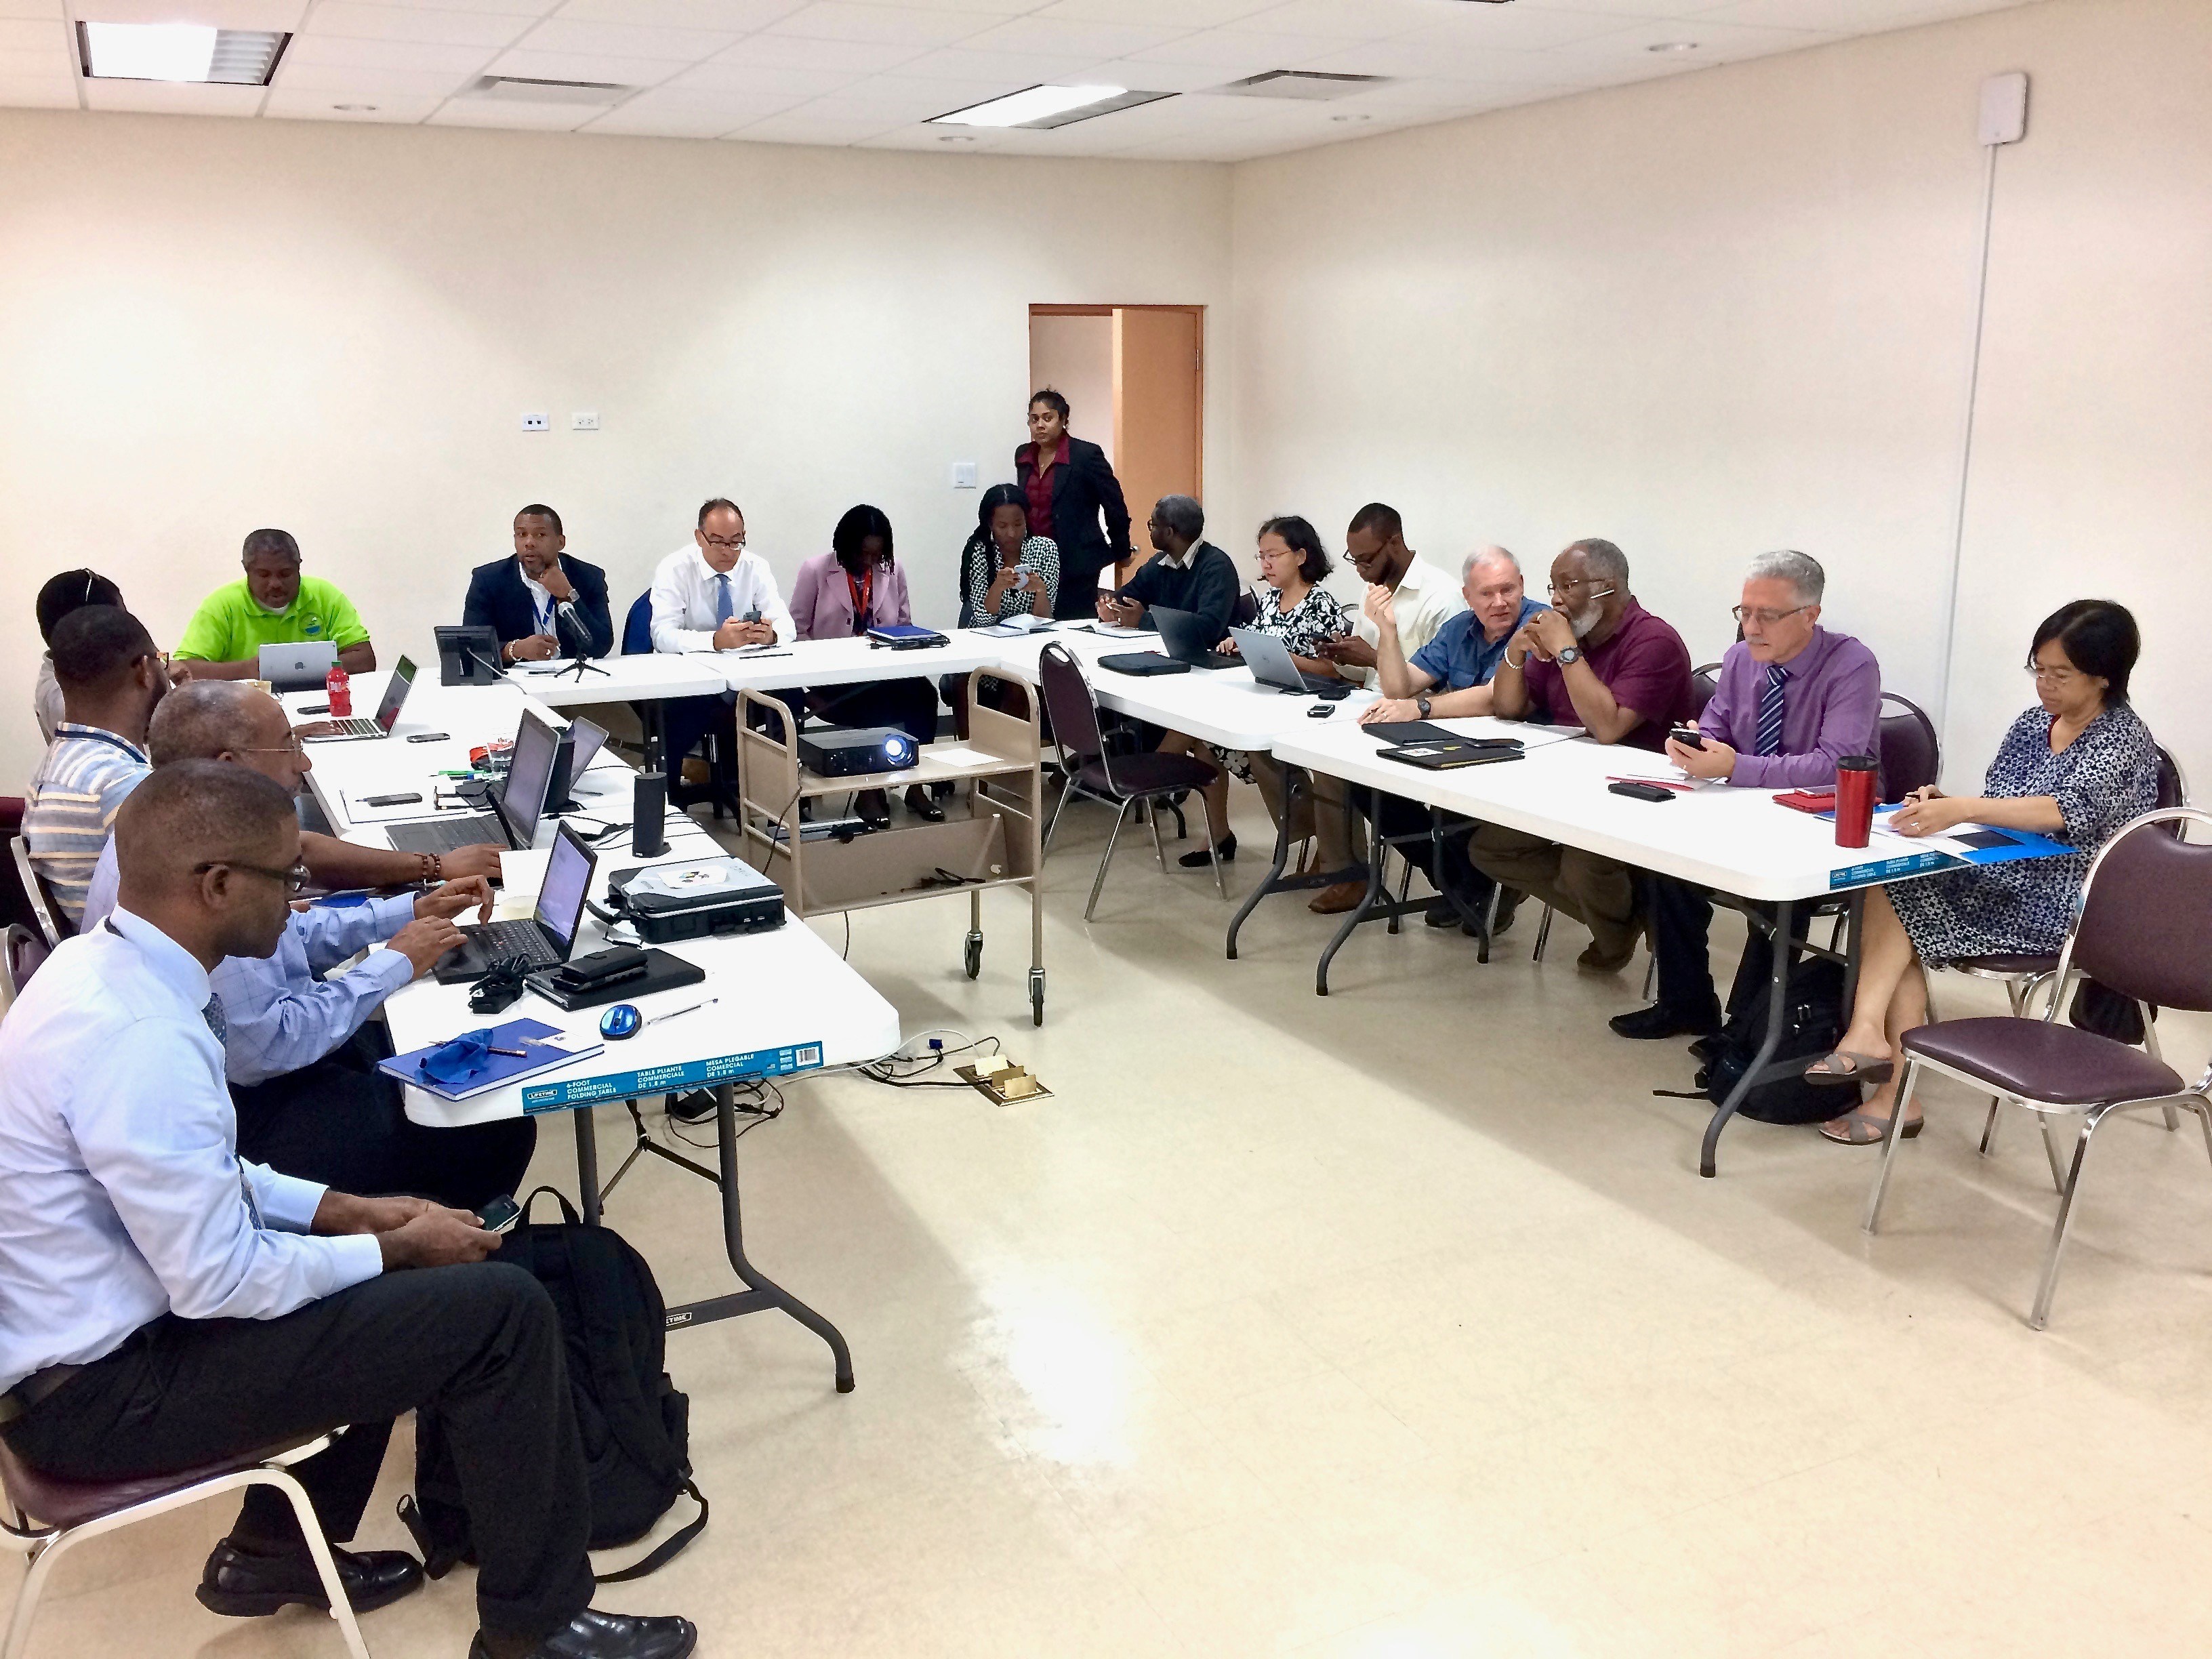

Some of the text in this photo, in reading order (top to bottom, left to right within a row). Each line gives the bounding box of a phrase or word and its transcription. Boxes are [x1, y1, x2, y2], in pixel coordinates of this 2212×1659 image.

[724, 1054, 754, 1063] PLEGABLE
[637, 1065, 682, 1078] TABLE PLIANTE
[706, 1061, 744, 1072] COMERCIAL
[637, 1071, 685, 1083] COMMERCIALE
[566, 1080, 590, 1088] 6-FOOT
[567, 1082, 613, 1094] COMMERCIAL
[567, 1091, 596, 1100] FOLDING
[598, 1087, 617, 1096] TABLE
[666, 1315, 687, 1324] ETIME
